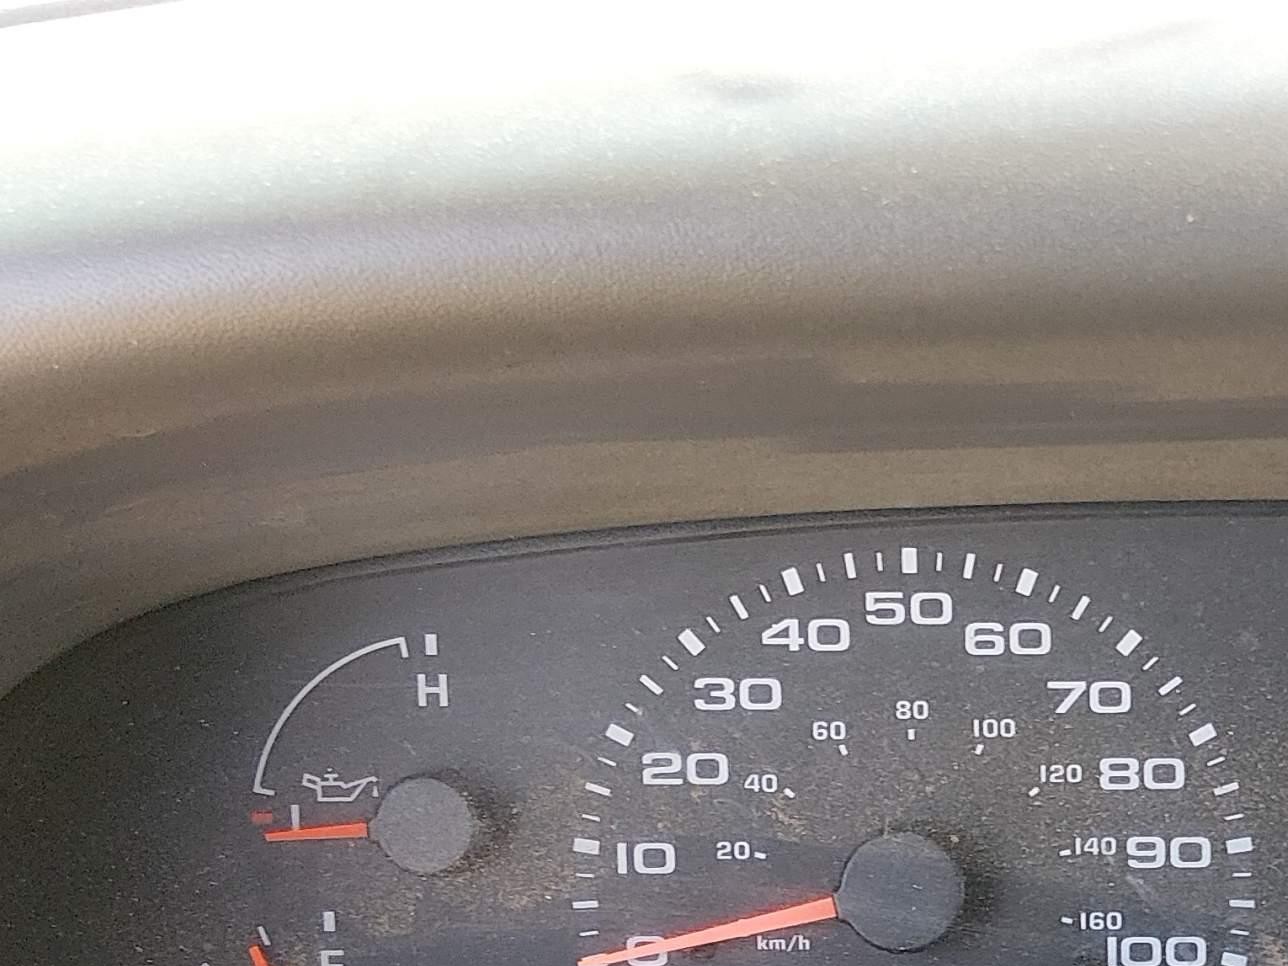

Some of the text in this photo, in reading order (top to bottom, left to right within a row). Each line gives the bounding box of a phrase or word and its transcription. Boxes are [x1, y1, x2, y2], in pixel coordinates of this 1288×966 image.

[865, 591, 953, 625] 50
[761, 618, 851, 652] 40
[964, 622, 1052, 656] 60
[416, 673, 449, 707] H
[694, 677, 782, 711] 30
[1047, 680, 1131, 714] 70
[895, 700, 929, 720] 80
[812, 721, 846, 741] 60
[972, 718, 1016, 738] 100
[641, 752, 729, 785] 20
[743, 774, 778, 793] 40
[1040, 764, 1083, 783] 120
[1099, 757, 1186, 791] 80
[616, 842, 677, 875] 10
[716, 841, 750, 860] 20
[1075, 836, 1117, 856] 140
[1126, 836, 1212, 869] 90
[1080, 911, 1122, 930] 160
[626, 935, 669, 966] 0
[756, 934, 811, 952] km/h
